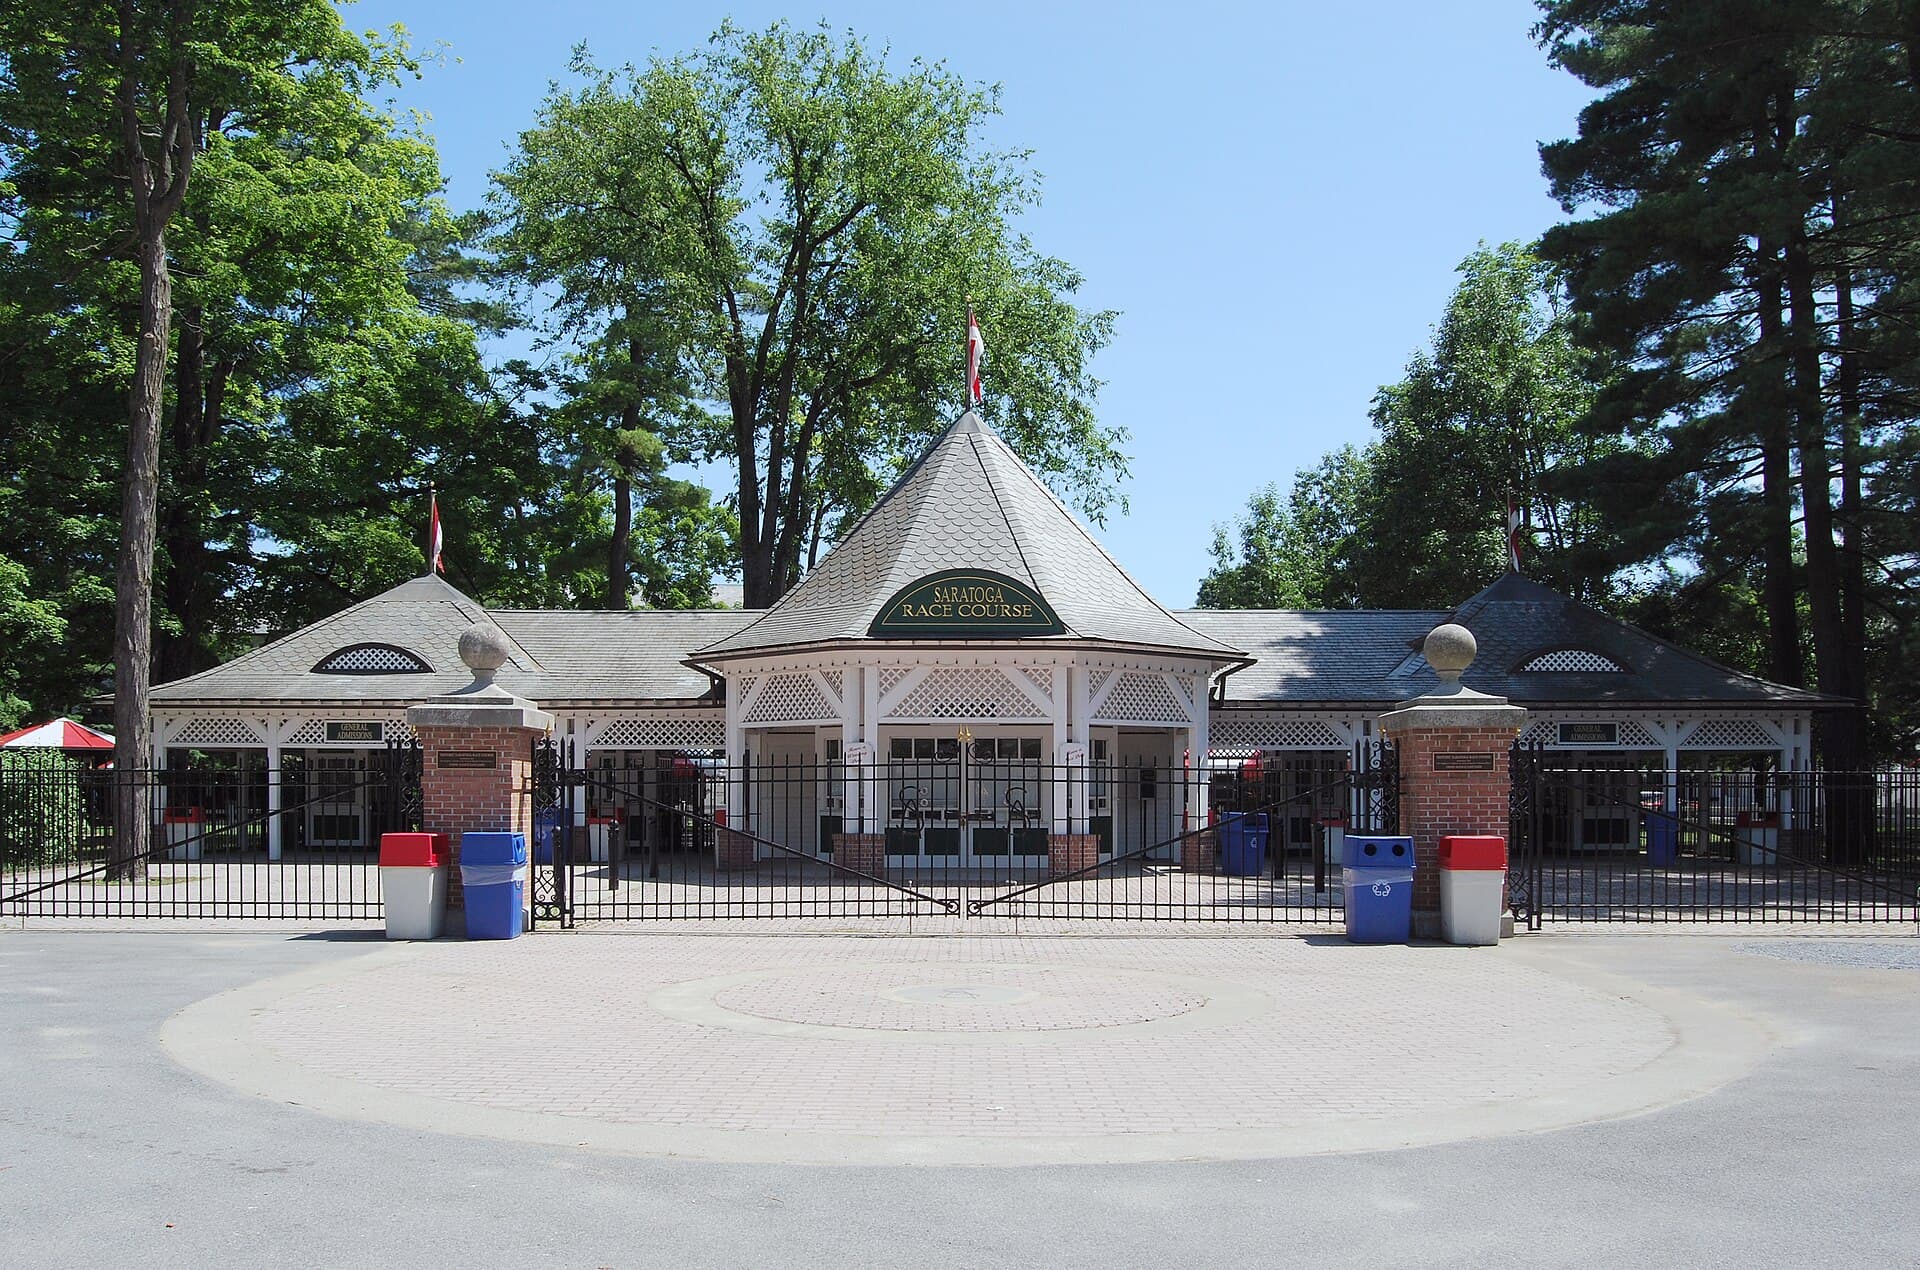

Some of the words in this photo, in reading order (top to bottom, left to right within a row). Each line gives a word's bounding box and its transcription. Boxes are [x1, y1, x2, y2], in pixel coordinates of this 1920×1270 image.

[934, 586, 1004, 603] SARATOGA
[902, 604, 953, 617] RACE
[958, 604, 1033, 617] COURSE
[340, 723, 369, 731] GENERAL
[337, 731, 373, 739] ADMISSIONS
